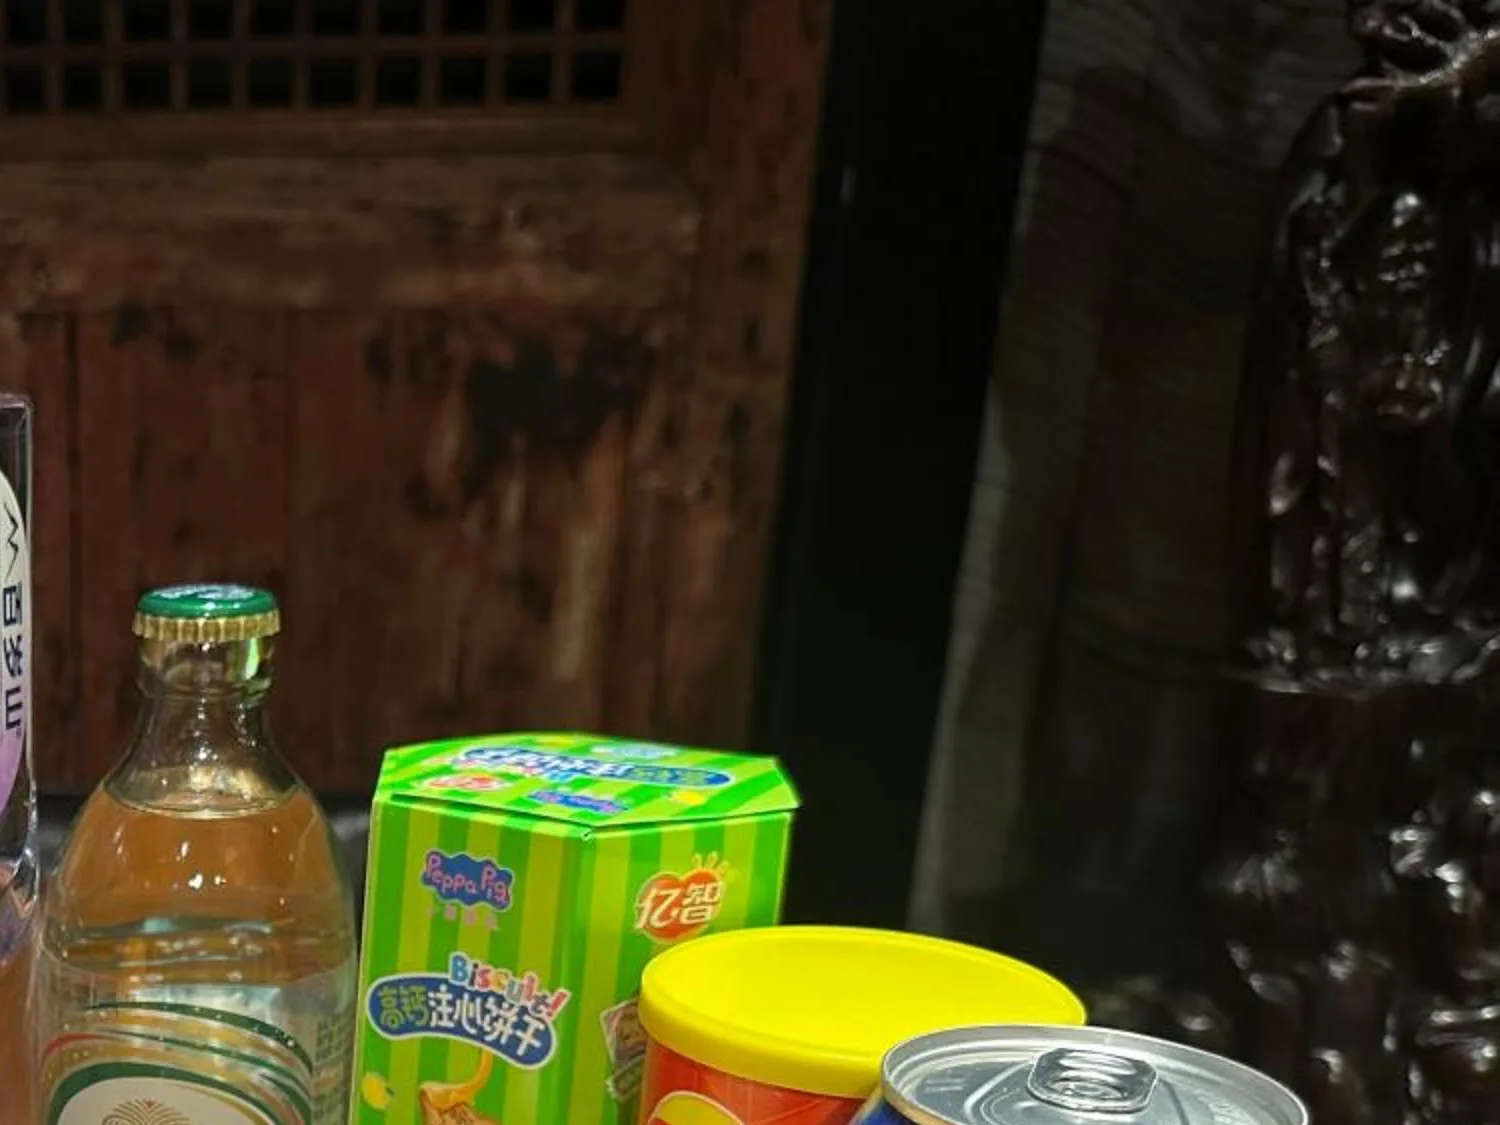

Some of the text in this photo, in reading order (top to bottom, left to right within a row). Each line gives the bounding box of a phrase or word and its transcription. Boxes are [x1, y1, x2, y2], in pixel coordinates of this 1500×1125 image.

[426, 852, 511, 906] Peppa Pig
[634, 879, 724, 930] 亿智
